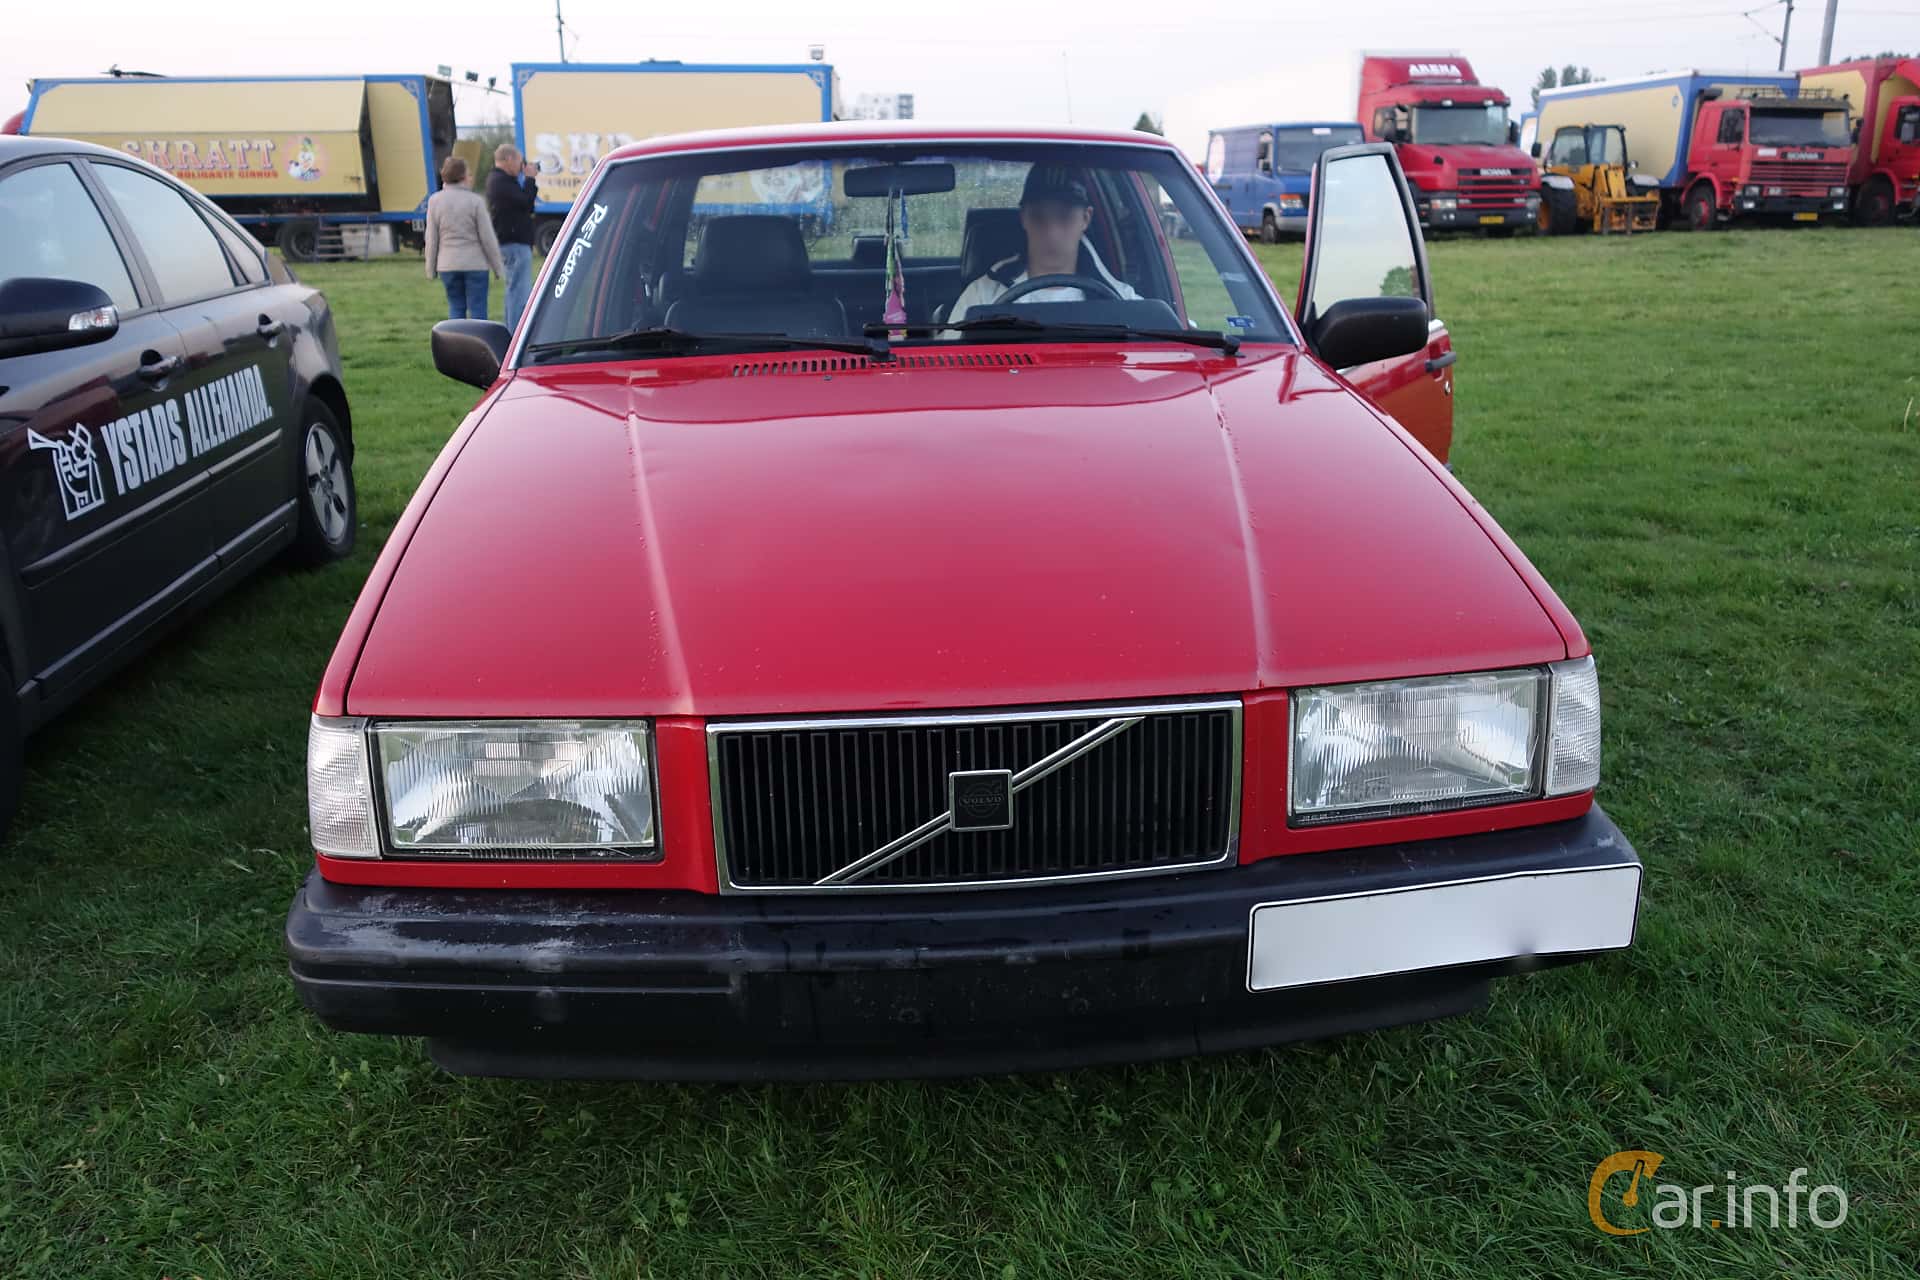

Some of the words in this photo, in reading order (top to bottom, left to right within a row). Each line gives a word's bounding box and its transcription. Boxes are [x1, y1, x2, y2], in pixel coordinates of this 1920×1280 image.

[1408, 63, 1462, 77] ARENA
[121, 138, 276, 170] SKRATT
[100, 398, 187, 496] YSTADS
